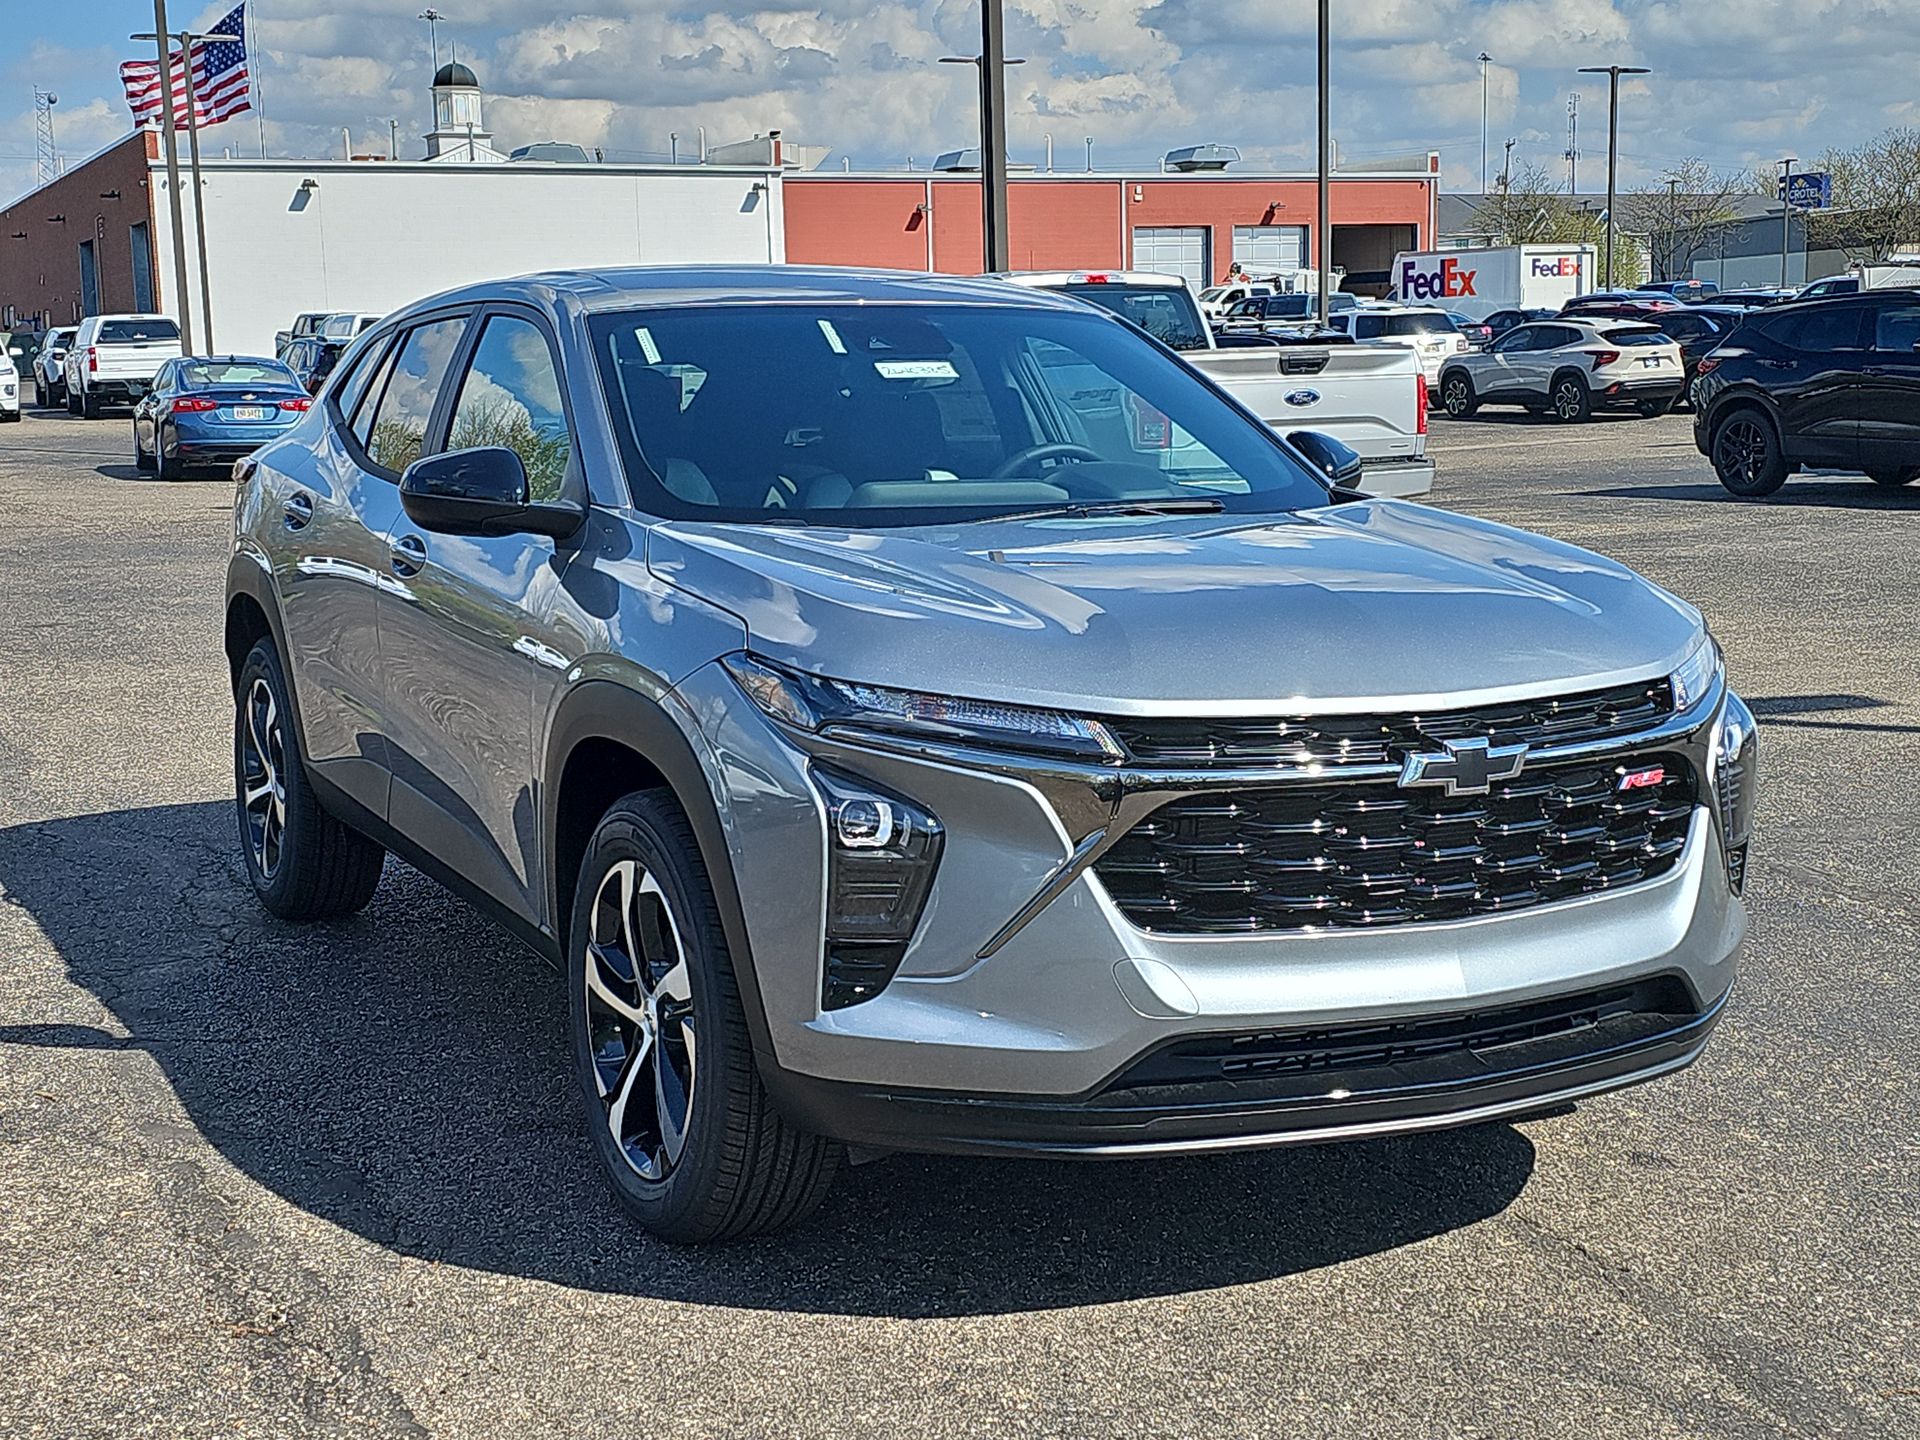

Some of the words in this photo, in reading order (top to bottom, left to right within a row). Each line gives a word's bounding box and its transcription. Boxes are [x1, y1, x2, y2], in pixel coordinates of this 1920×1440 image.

[1532, 257, 1582, 277] FedEx
[1402, 258, 1477, 300] FedEx
[1619, 769, 1665, 790] RS
